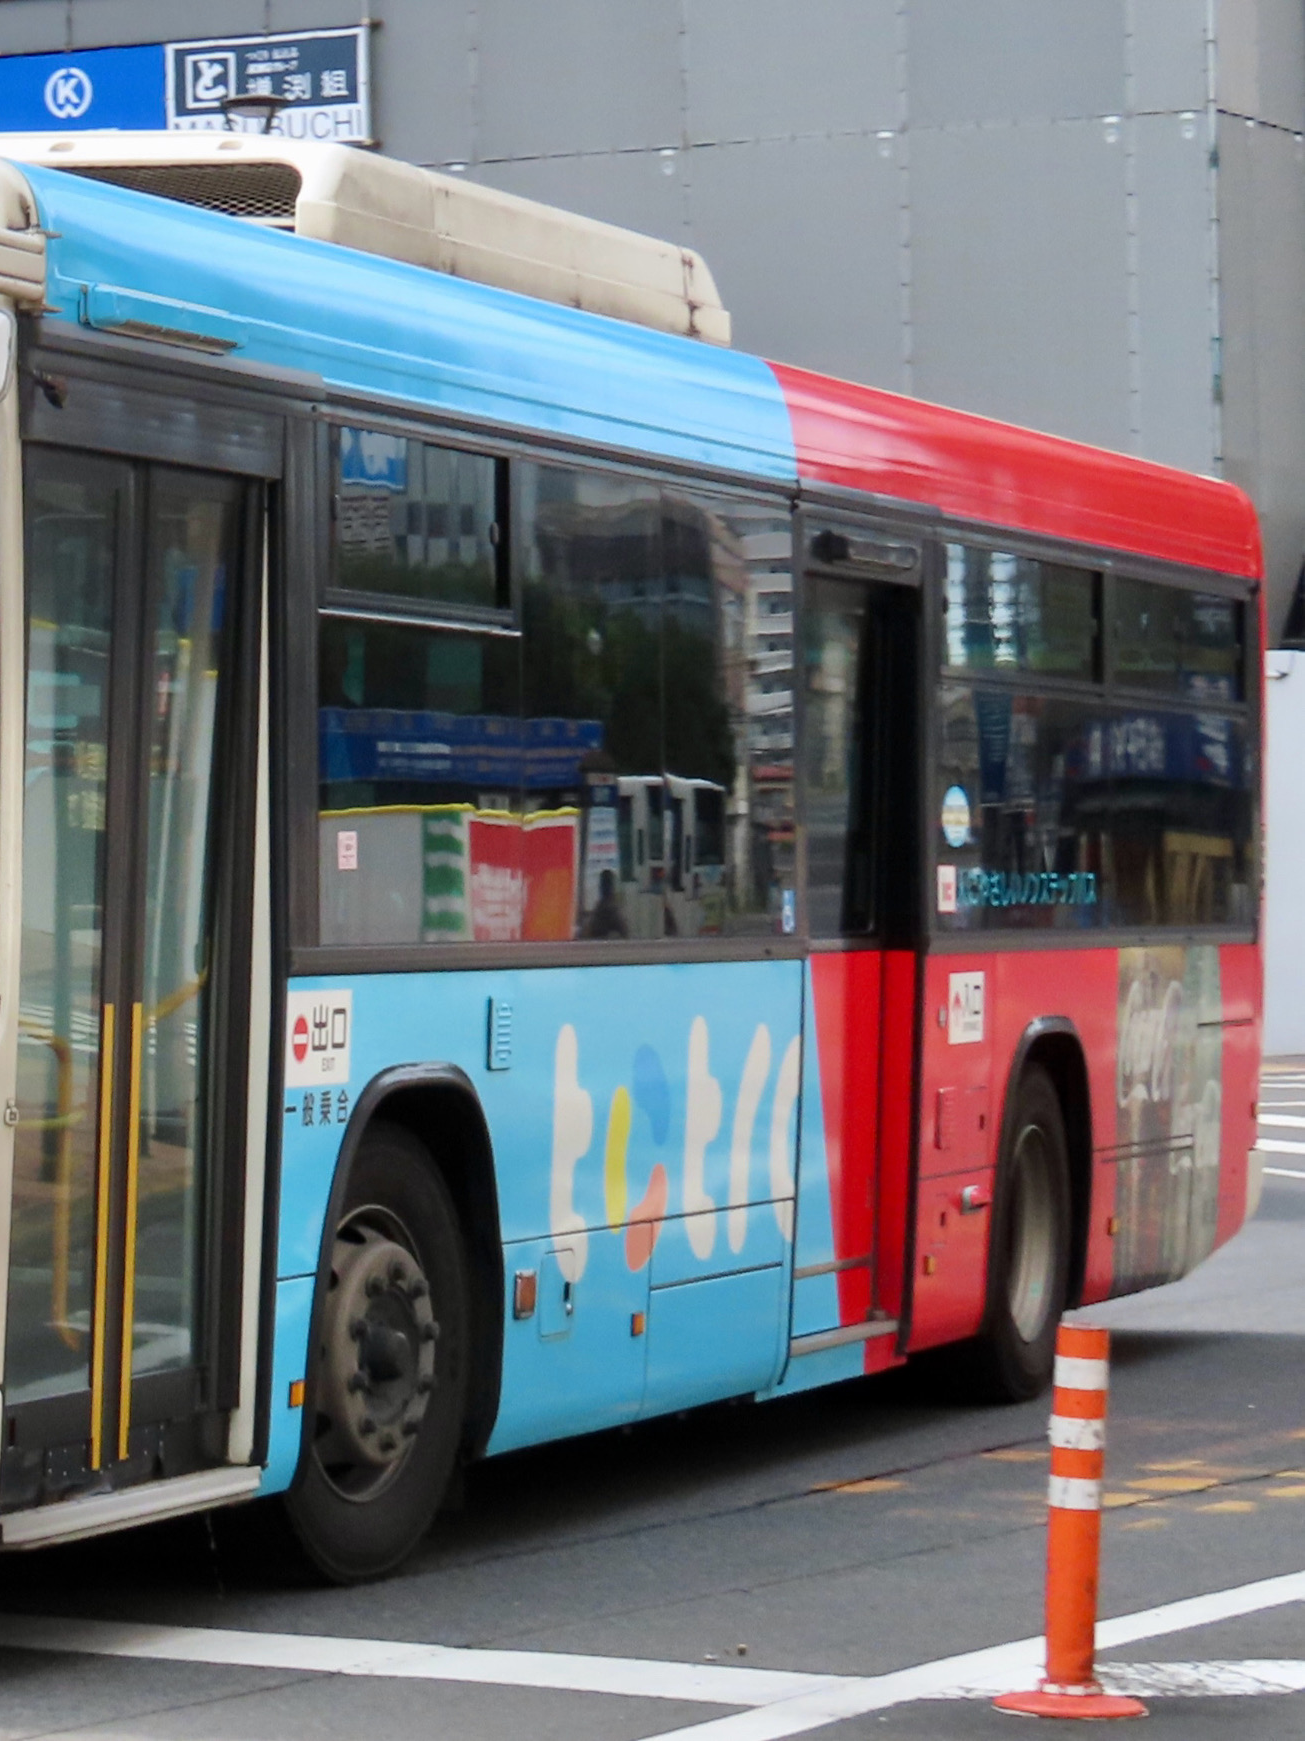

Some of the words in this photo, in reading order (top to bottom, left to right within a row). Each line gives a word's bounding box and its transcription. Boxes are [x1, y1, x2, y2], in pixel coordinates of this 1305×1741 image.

[196, 61, 227, 100] と
[311, 1003, 347, 1051] 出口
[285, 1089, 349, 1127] 一般乗合
